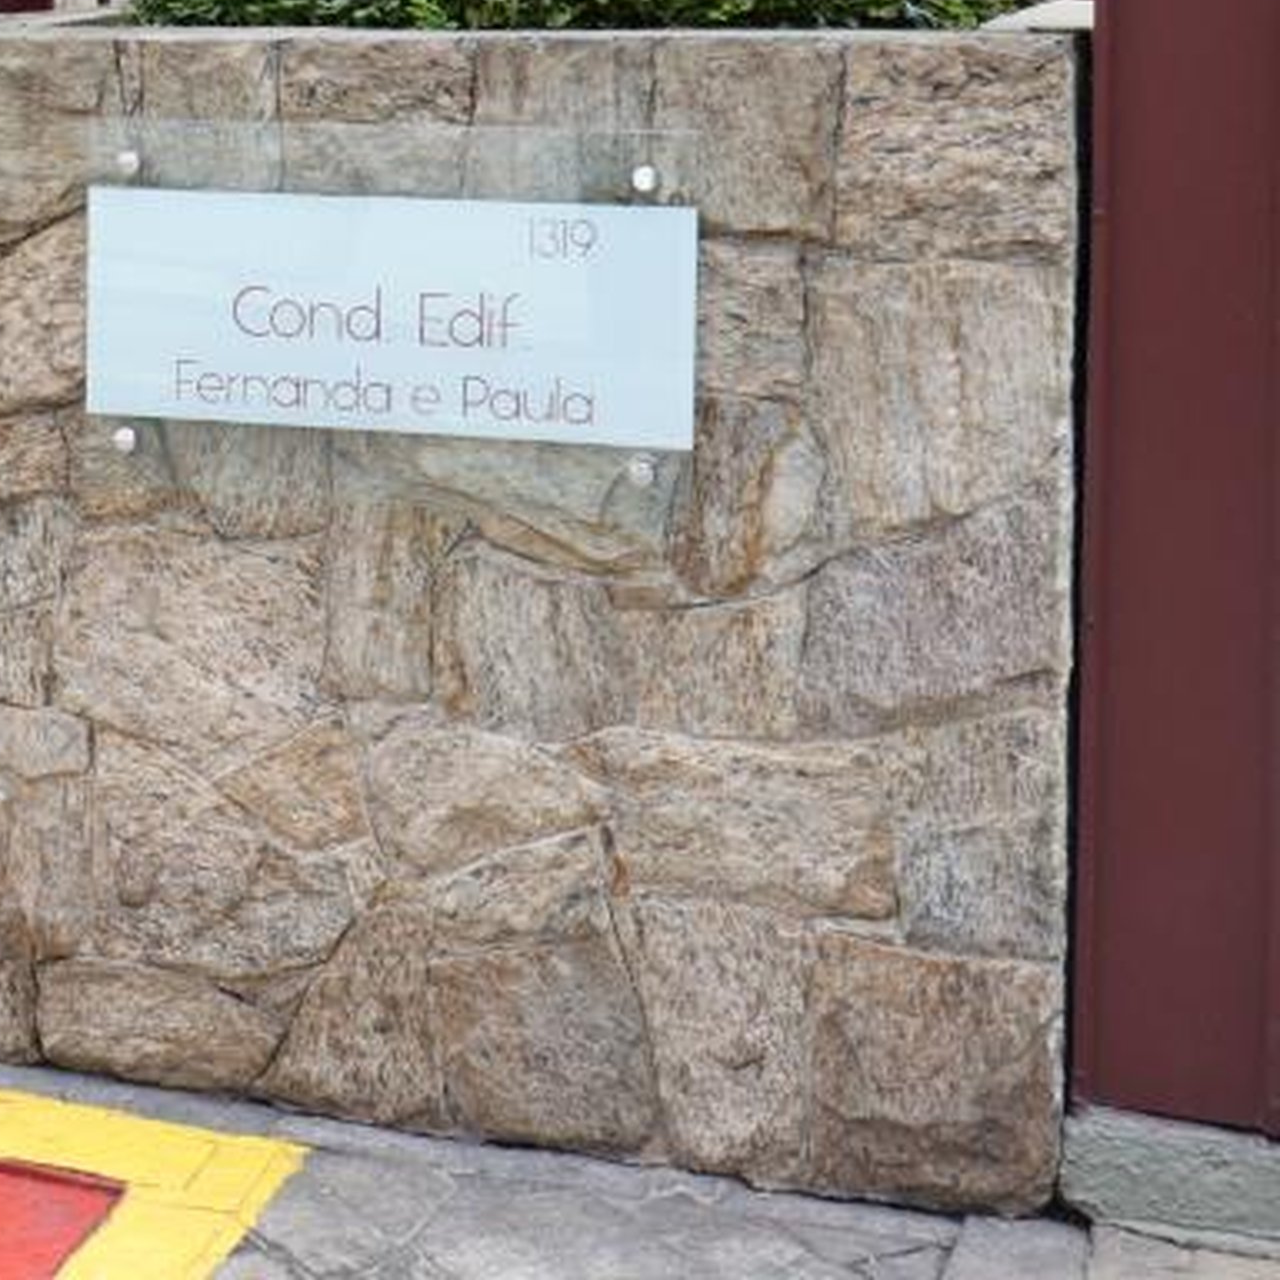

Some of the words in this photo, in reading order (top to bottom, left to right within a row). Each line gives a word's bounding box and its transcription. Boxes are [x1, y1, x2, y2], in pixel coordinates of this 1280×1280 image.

[526, 216, 599, 261] 1319
[174, 358, 393, 414] Fernanda
[410, 384, 441, 415] e
[461, 374, 596, 426] Paula
